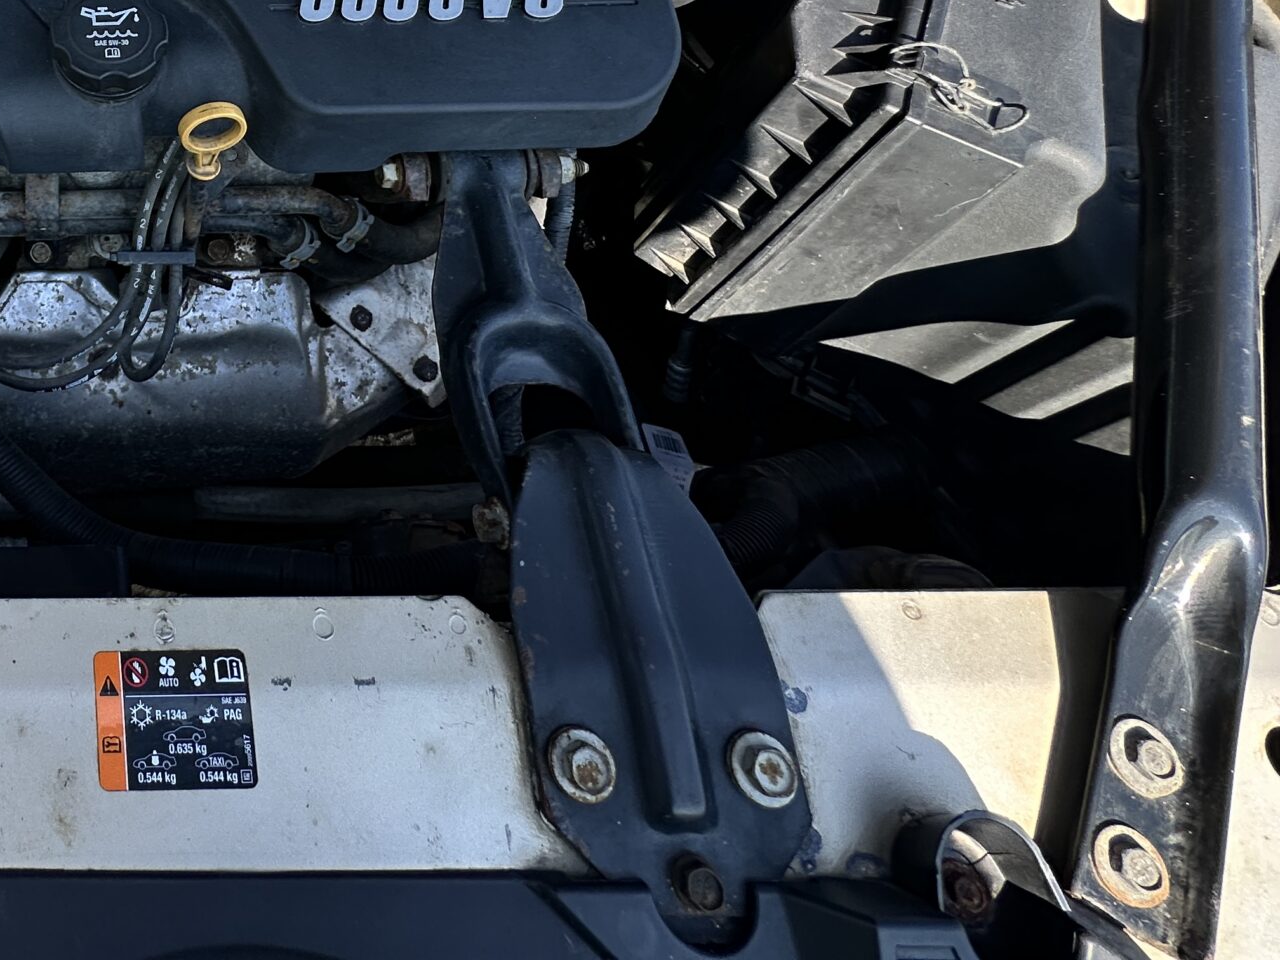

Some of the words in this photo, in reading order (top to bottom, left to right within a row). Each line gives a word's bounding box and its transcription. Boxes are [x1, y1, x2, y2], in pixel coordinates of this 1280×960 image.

[159, 678, 179, 687] AUTO
[155, 709, 187, 720] R-134a
[224, 709, 242, 720] PAG
[169, 743, 193, 754] 0.635
[195, 743, 207, 756] kg
[209, 757, 224, 766] TAXI
[138, 772, 162, 783] 0.544
[164, 772, 176, 784] kg
[200, 772, 225, 782] 0.544
[227, 771, 238, 784] kg
